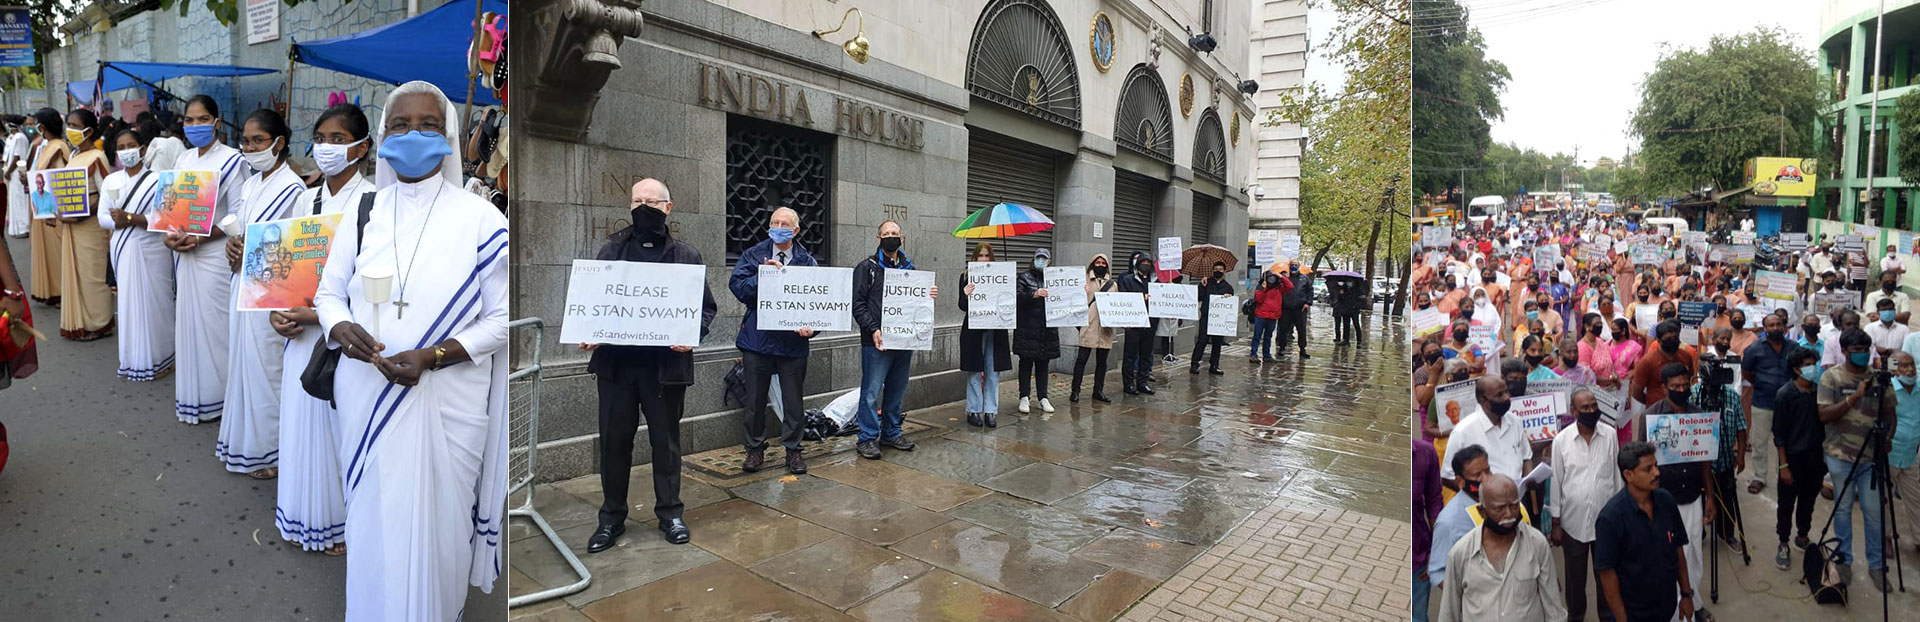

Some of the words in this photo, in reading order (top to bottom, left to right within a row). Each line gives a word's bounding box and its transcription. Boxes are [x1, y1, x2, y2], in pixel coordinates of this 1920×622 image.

[699, 62, 815, 125] INDIA
[836, 97, 925, 150] HOUSE
[883, 203, 908, 221] भारत
[301, 220, 321, 238] Today
[293, 238, 305, 248] our
[306, 236, 328, 247] voices
[1160, 242, 1180, 250] JUSTICE
[292, 251, 304, 260] are
[970, 275, 1008, 284] JUSTICE
[1045, 278, 1079, 289] JUSTICE
[605, 284, 669, 298] RELEASE
[783, 285, 829, 295] RELEASE
[884, 285, 927, 298] JUSTICE
[969, 293, 987, 301] FOR
[760, 300, 773, 310] FR
[776, 301, 806, 311] STAN
[809, 302, 850, 311] SWAMY
[1209, 302, 1233, 310] JUSTICE
[568, 304, 586, 317] FR
[592, 304, 634, 318] STAN
[639, 307, 698, 319] SWAMY
[883, 306, 903, 316] FOR
[592, 329, 670, 341] #StandwithStan
[882, 326, 892, 334] FR
[893, 326, 914, 335] STAN
[1522, 399, 1537, 408] We
[1679, 417, 1714, 425] Release
[1680, 429, 1691, 437] Fr.
[1693, 428, 1713, 436] Stan
[1681, 449, 1709, 458] others
